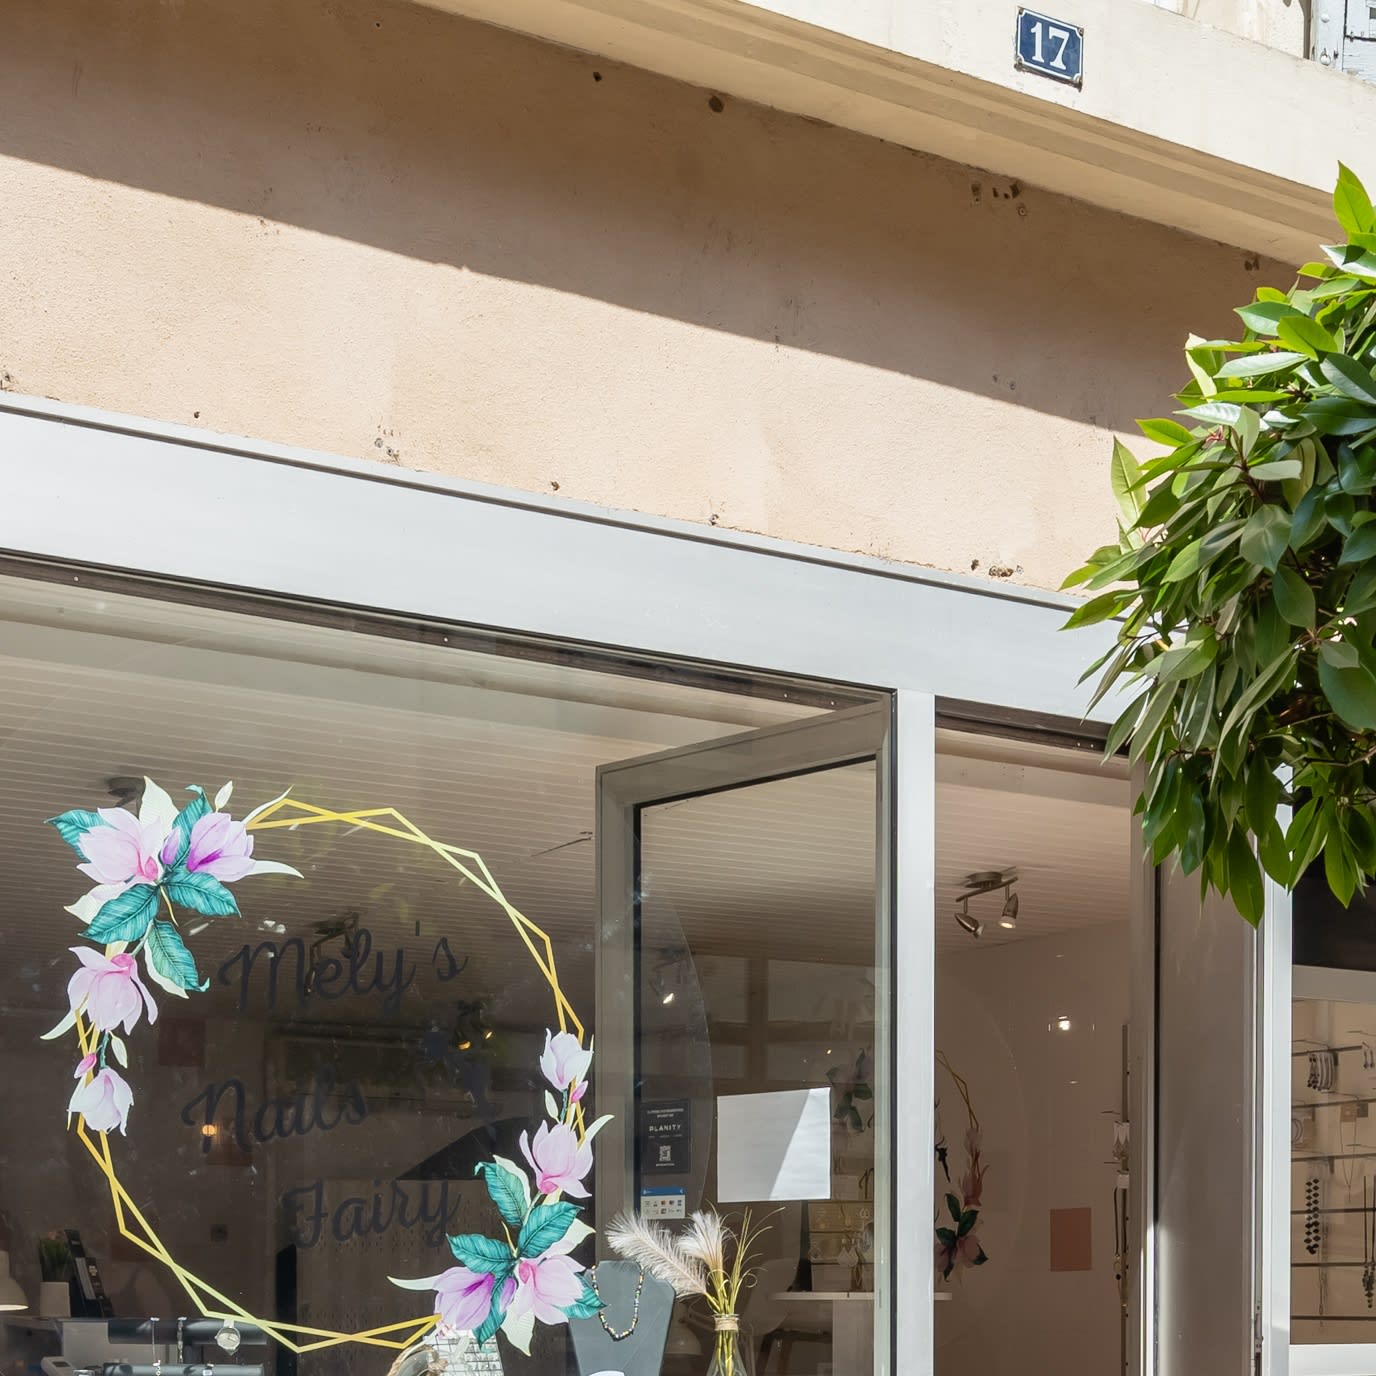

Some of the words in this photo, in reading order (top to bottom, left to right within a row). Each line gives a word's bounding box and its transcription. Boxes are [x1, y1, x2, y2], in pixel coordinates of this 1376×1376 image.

[1030, 22, 1069, 70] 17
[217, 919, 469, 1014] Mely's
[649, 1124, 682, 1132] PLANITY
[281, 1177, 461, 1249] Fairy
